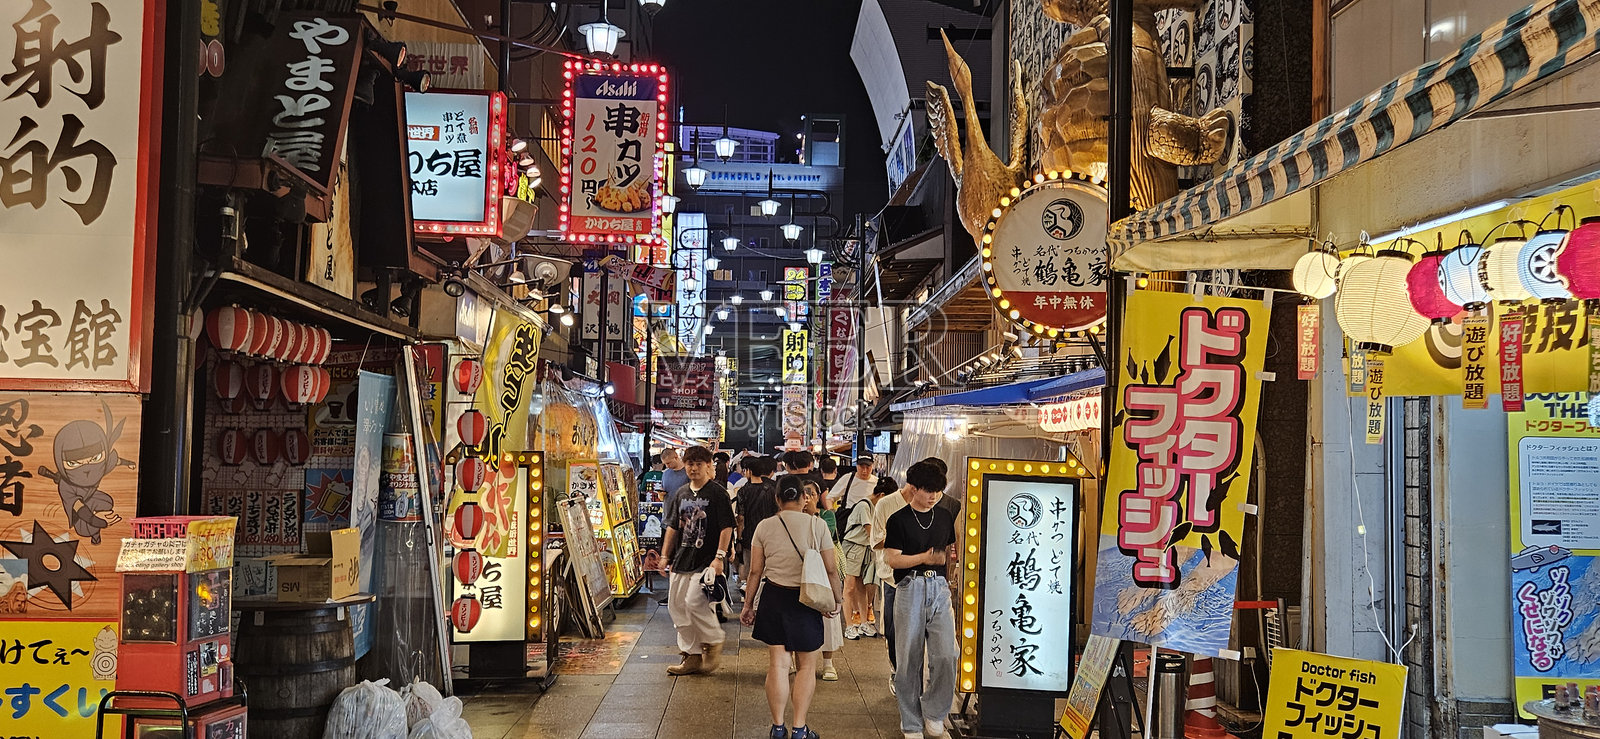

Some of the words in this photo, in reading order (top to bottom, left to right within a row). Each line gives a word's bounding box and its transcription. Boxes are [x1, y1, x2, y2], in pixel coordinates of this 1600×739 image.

[405, 54, 469, 76] 新世界
[262, 17, 349, 173] やまと屋
[596, 80, 637, 98] Asahi
[0, 0, 122, 226] 射的
[442, 112, 454, 144] 串カツ
[604, 102, 641, 188] 串カツ
[584, 216, 634, 231] かわち屋
[1010, 245, 1022, 275] 串かつ
[1033, 244, 1060, 257] 名代
[1033, 256, 1107, 287] 鶴亀家
[1033, 295, 1095, 310] 年中無休
[584, 322, 621, 336] 沢鶴
[1298, 312, 1319, 373] 好き放題
[785, 332, 806, 373] 射的
[1464, 326, 1487, 401] 遊び放題
[1501, 323, 1522, 403] 好き放題
[660, 374, 710, 389] ビリーズ
[672, 387, 697, 395] SHOP
[1178, 308, 1246, 526] ドクター
[1367, 368, 1384, 436] 遊び放題
[1121, 386, 1180, 584] フィッシュ
[1007, 531, 1043, 546] 名代
[1049, 496, 1068, 544] 串かつ
[1047, 548, 1063, 595] どて焼
[1006, 547, 1045, 677] 鶴亀家
[1520, 585, 1551, 668] くせになる
[1301, 661, 1346, 680] Doctor
[1349, 669, 1377, 685] fish
[1294, 677, 1380, 712] ドクター
[1284, 701, 1381, 739] フィッシュ
